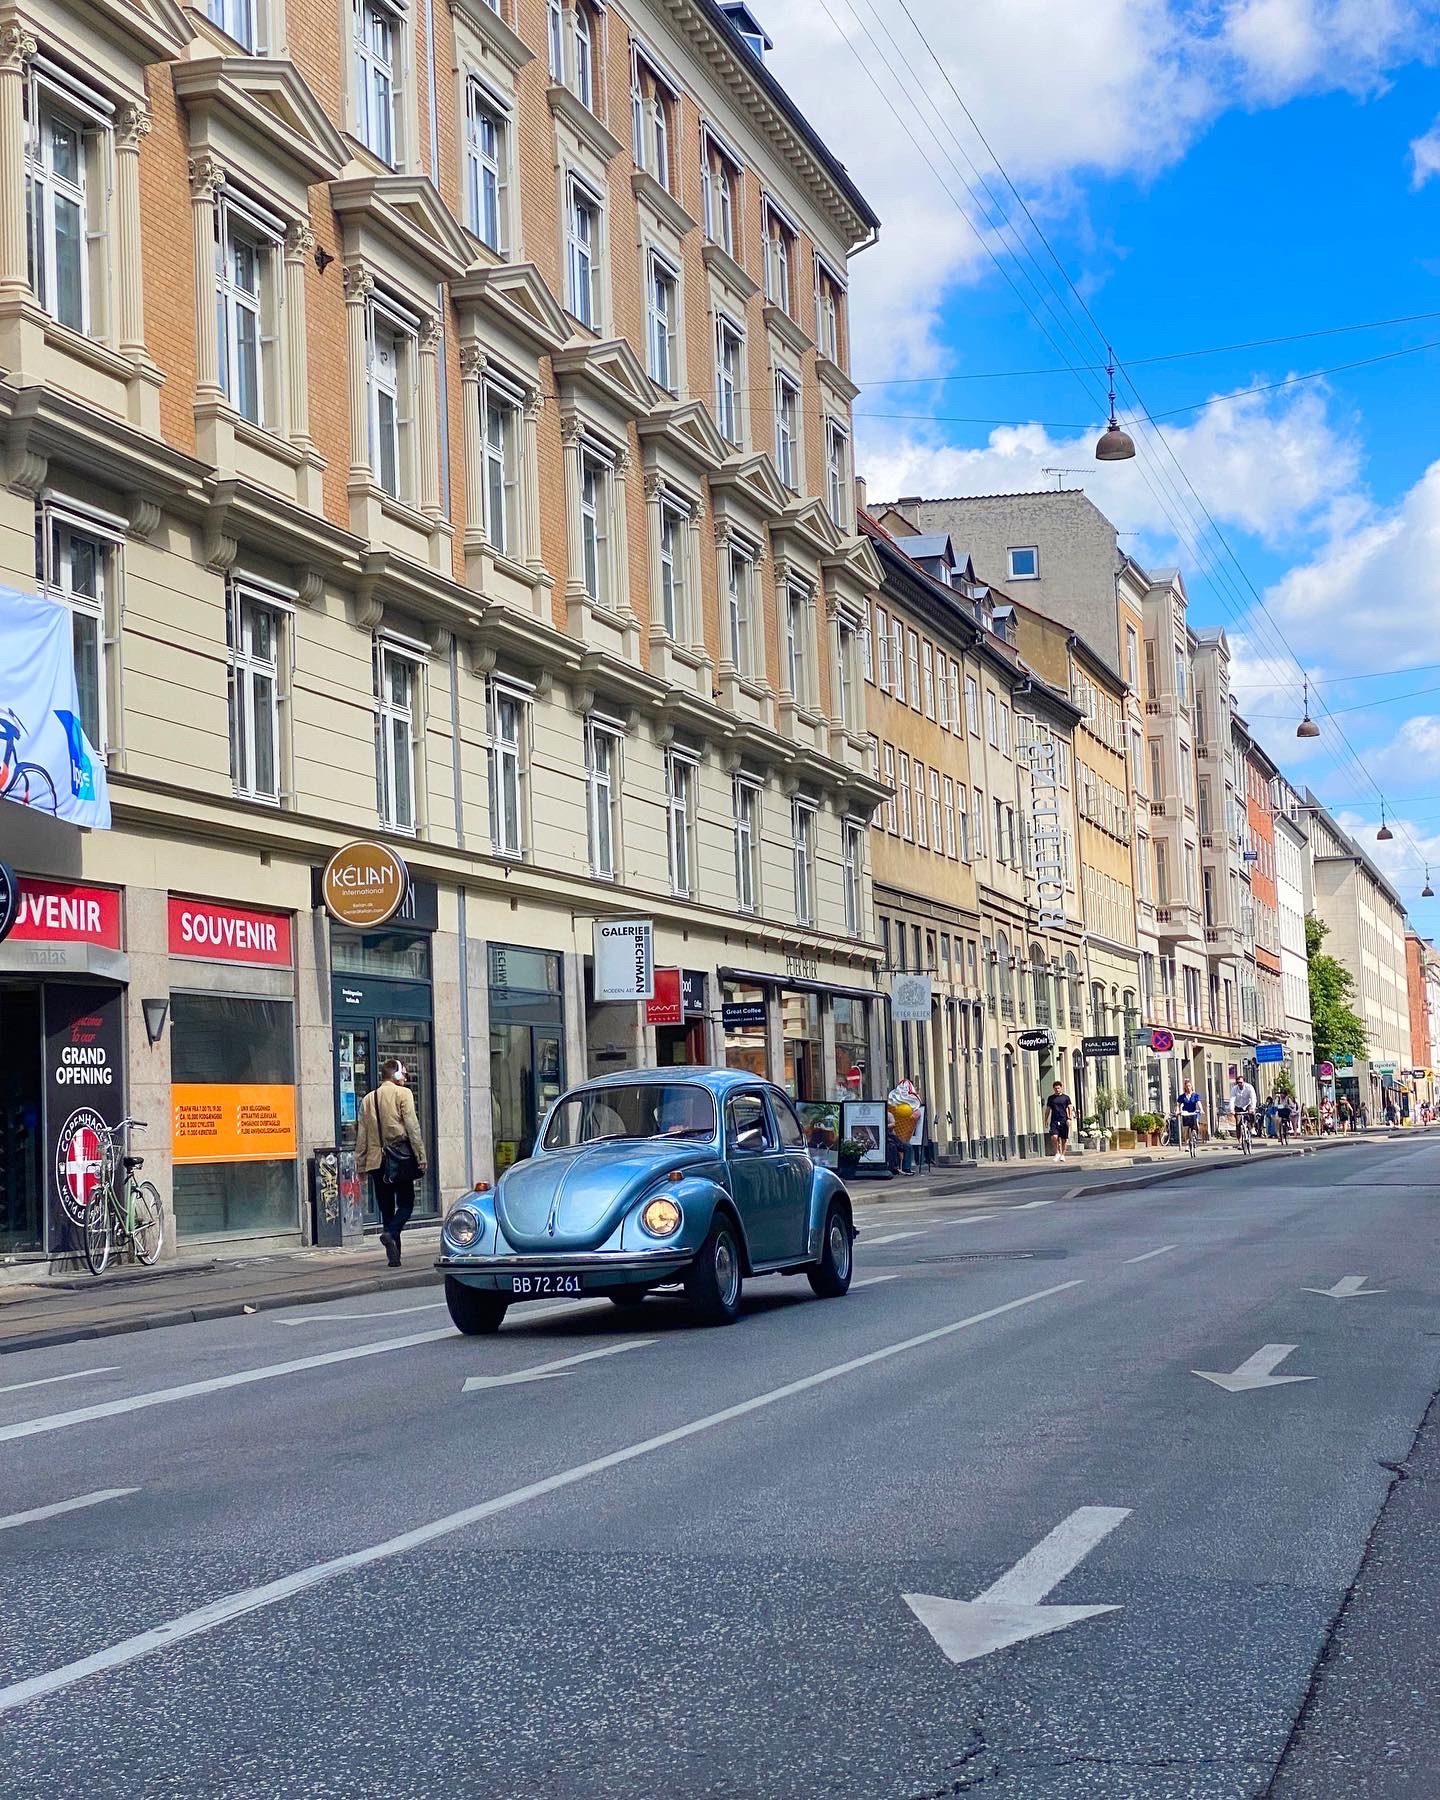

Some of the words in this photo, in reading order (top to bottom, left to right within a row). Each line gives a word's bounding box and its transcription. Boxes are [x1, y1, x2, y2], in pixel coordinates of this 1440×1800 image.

[332, 864, 393, 887] KÉLIAN
[342, 887, 384, 896] international
[181, 912, 277, 952] SOUVENIR
[601, 926, 643, 937] GALERIE
[635, 936, 644, 993] BECHMAN
[62, 1046, 106, 1065] GRAND
[55, 1066, 112, 1085] OPENING
[512, 1277, 531, 1293] BB
[534, 1275, 581, 1293] 72.261
